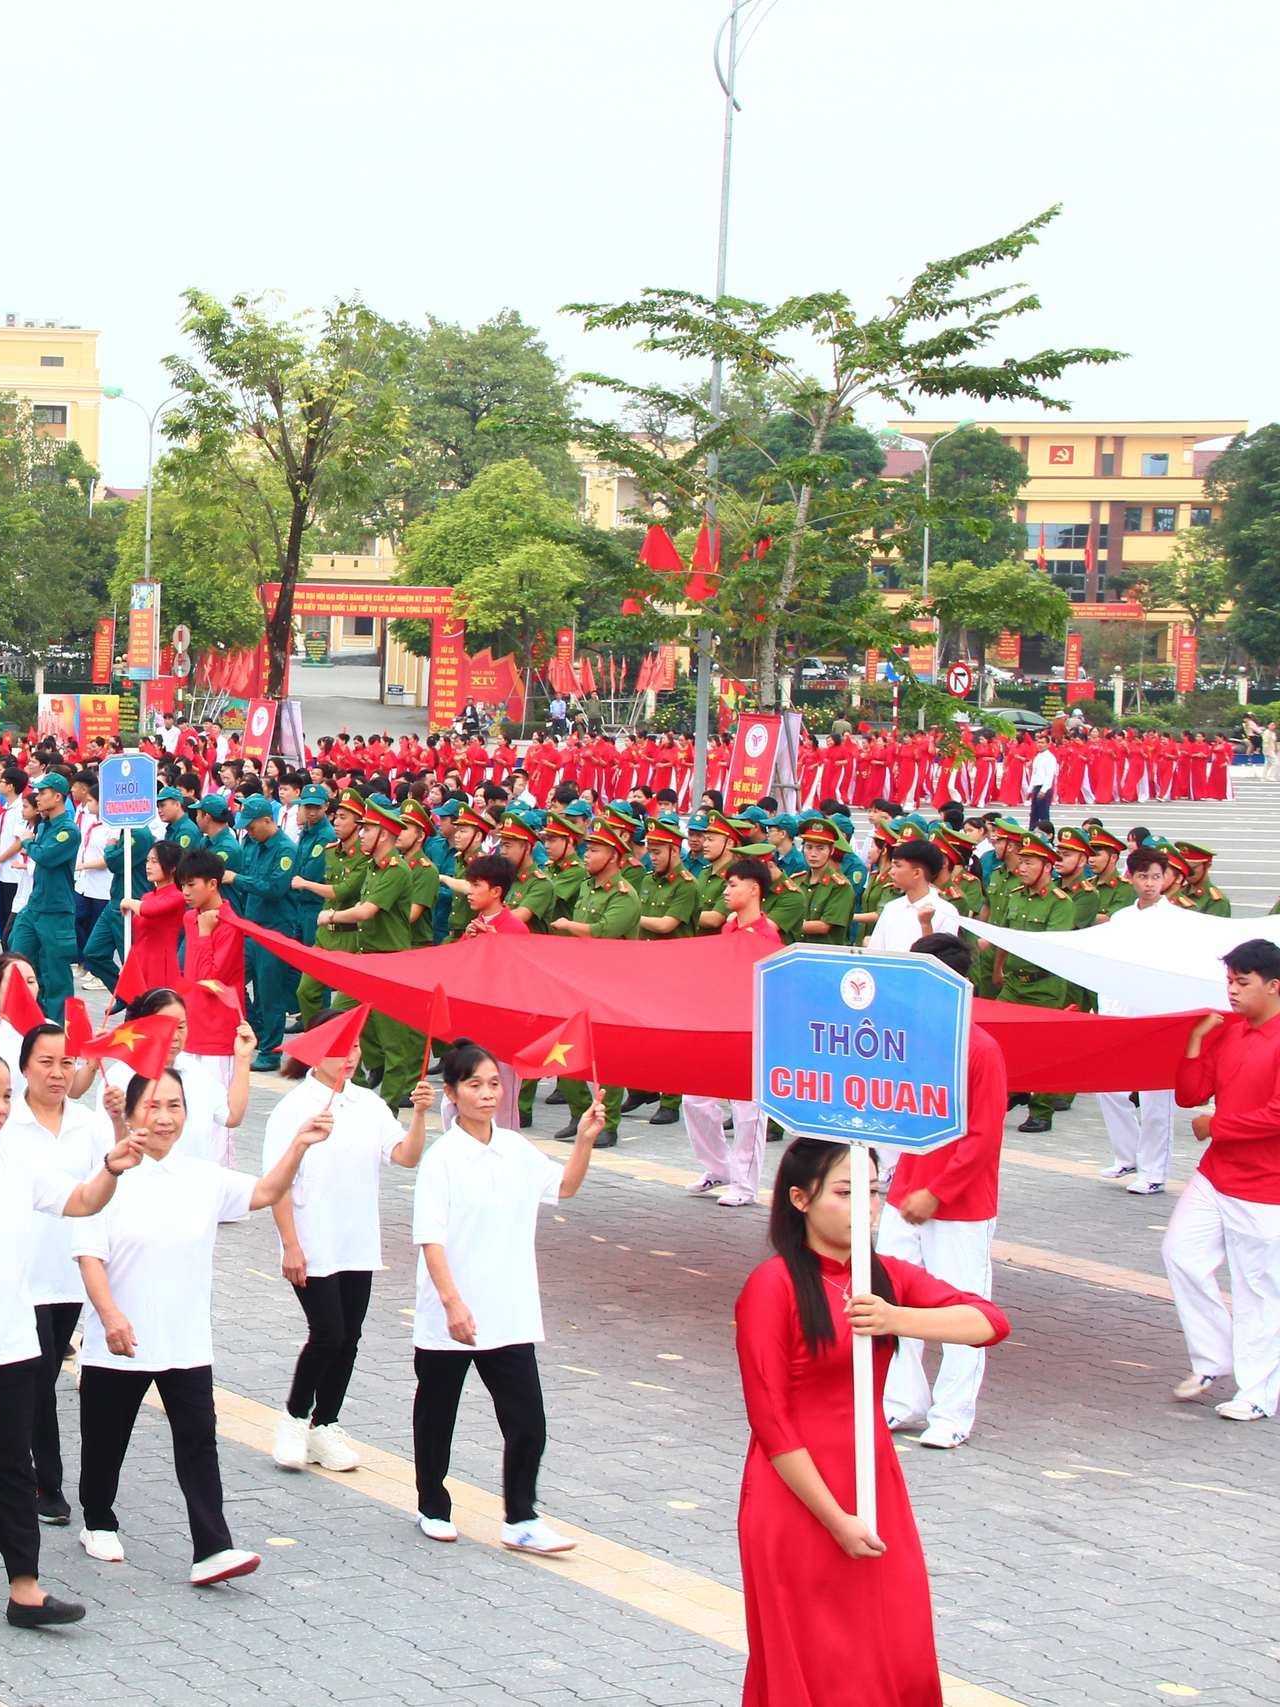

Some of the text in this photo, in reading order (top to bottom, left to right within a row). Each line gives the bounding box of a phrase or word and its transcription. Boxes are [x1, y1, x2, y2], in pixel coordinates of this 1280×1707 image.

[471, 677, 497, 685] XIV
[115, 776, 138, 795] KHỐI
[751, 782, 763, 795] TẬP
[809, 1018, 906, 1062] THÔN
[770, 1067, 948, 1118] CHI QUAN
